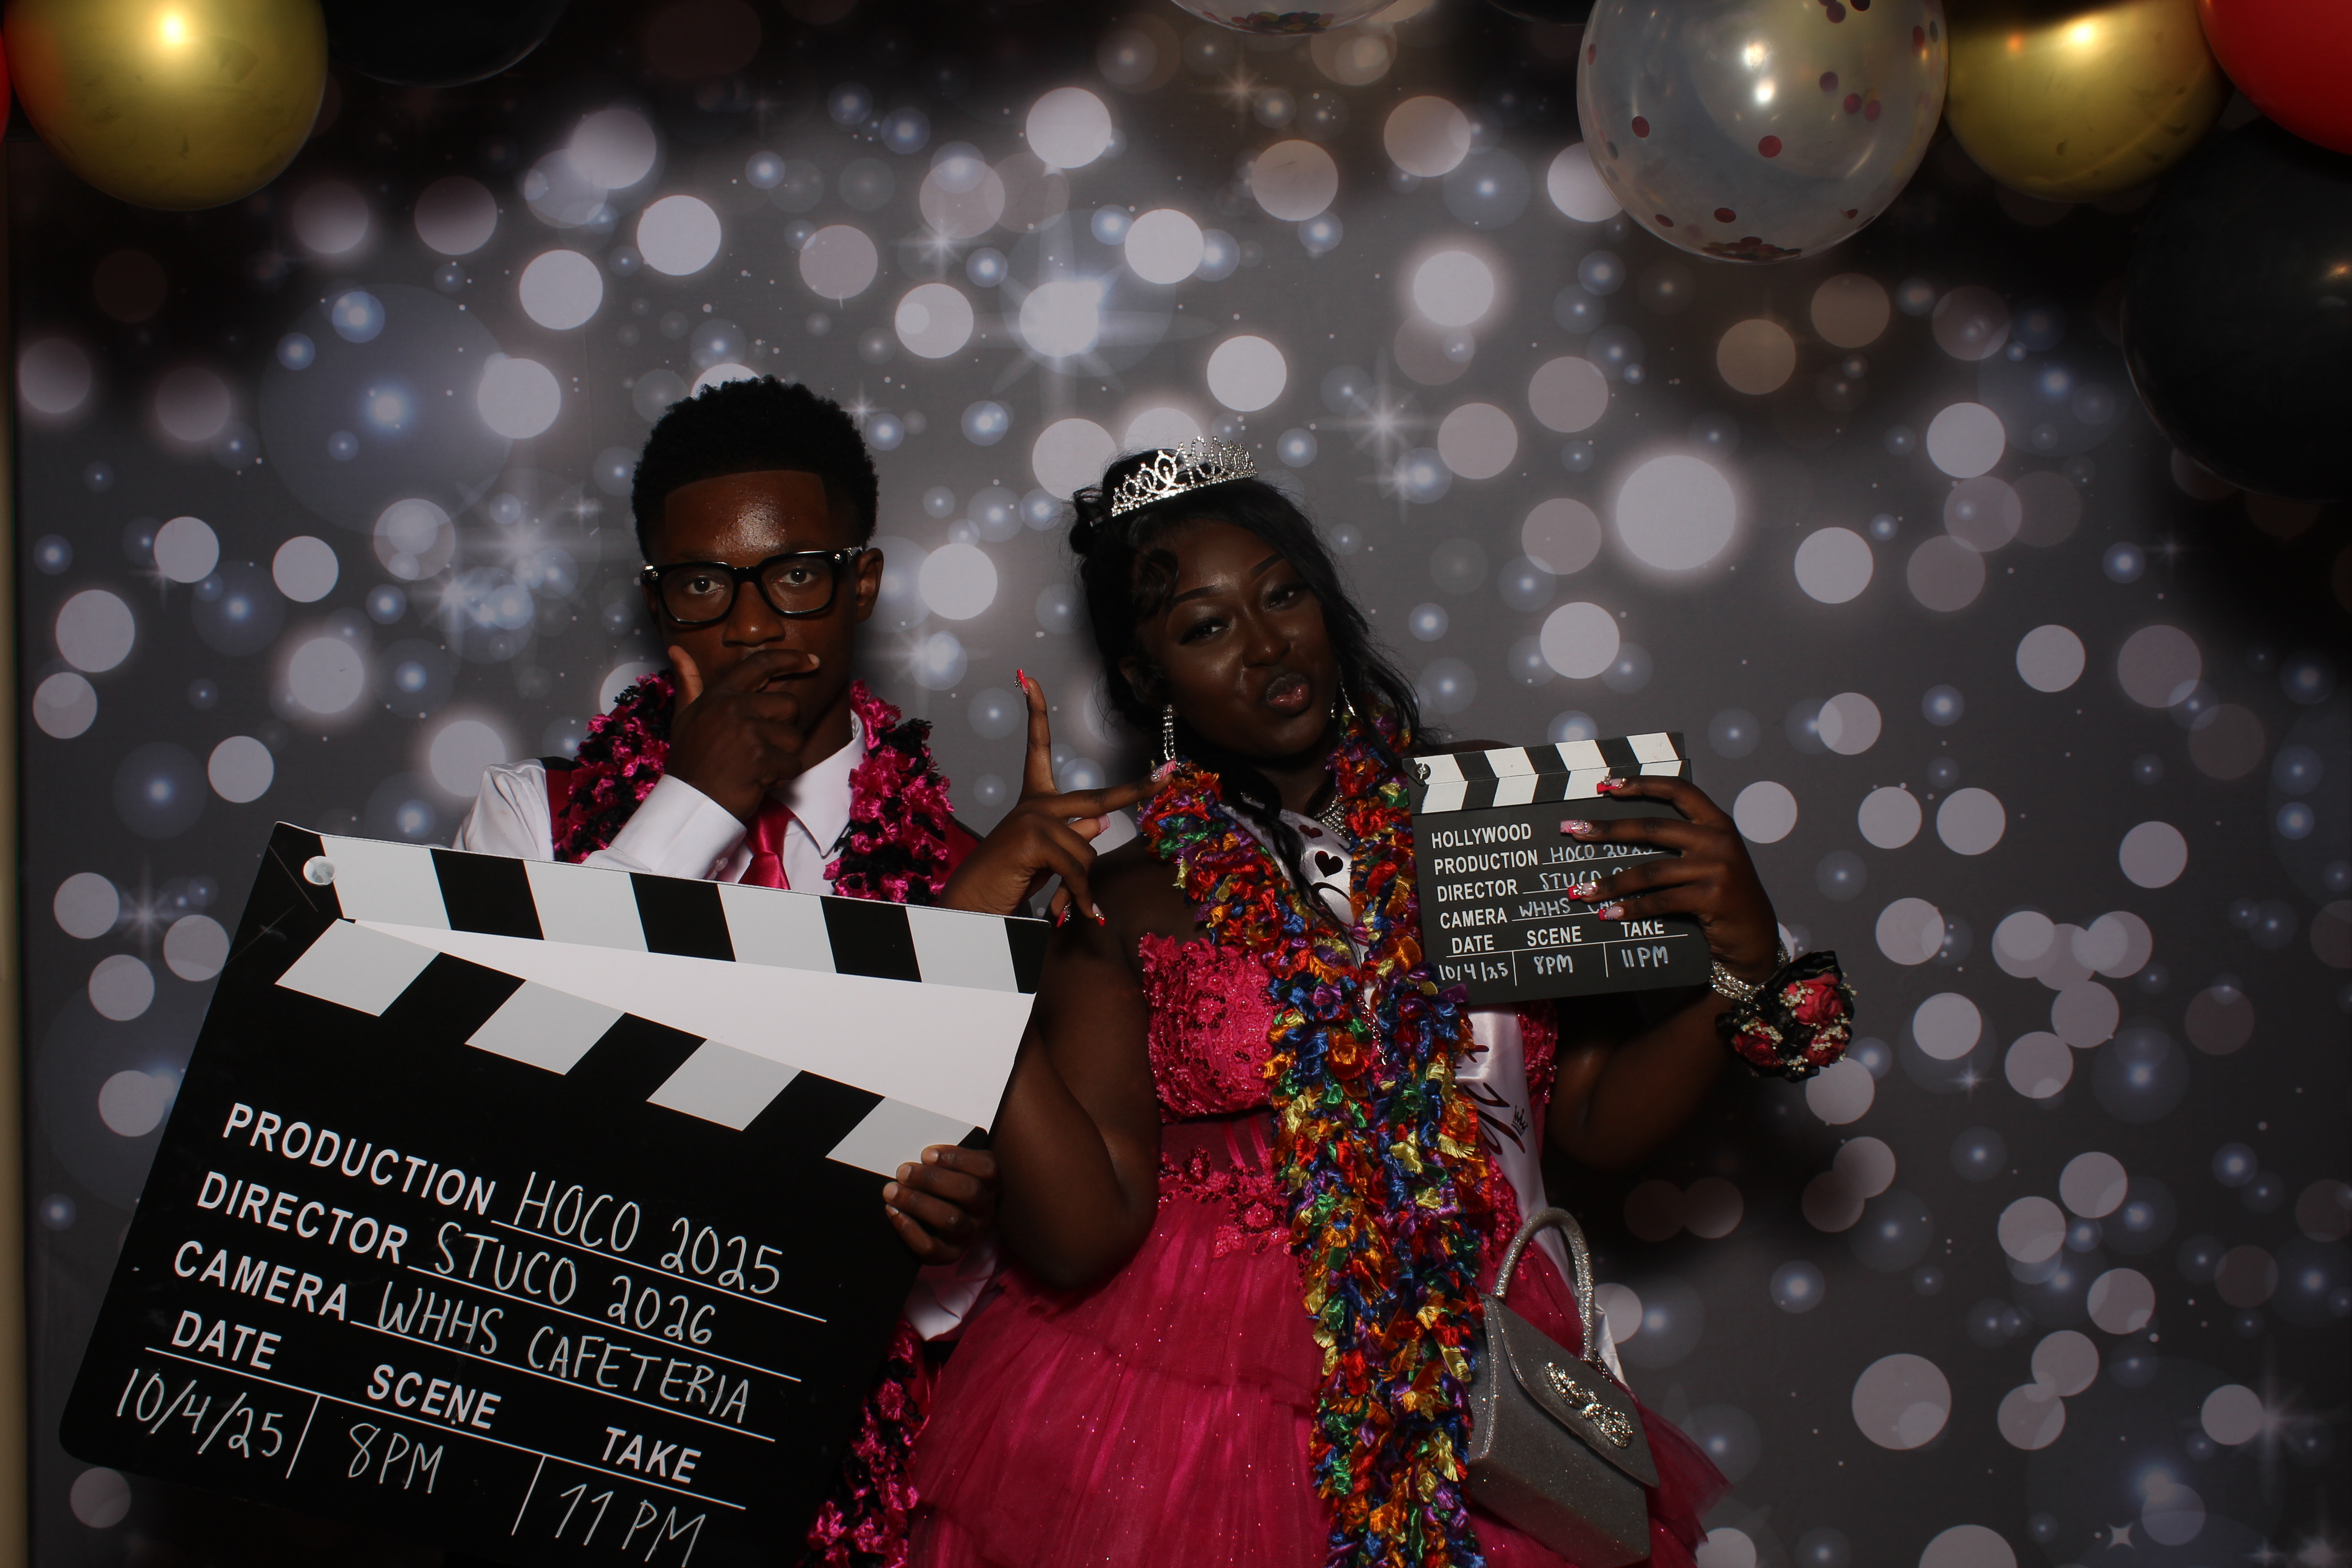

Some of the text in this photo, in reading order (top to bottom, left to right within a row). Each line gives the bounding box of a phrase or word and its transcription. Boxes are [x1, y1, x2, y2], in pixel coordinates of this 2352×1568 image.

[1431, 823, 1531, 849] HOLLYWOOD
[1434, 849, 1538, 875] PRODUCTION
[1550, 844, 1595, 862] HOCO
[1437, 879, 1518, 902] DIRECTOR
[1440, 907, 1508, 929] CAMERA
[1519, 897, 1571, 917] WHHS
[1620, 920, 1665, 937] TAKE
[1451, 934, 1494, 954] DATE
[1527, 926, 1582, 947] SCENE
[1439, 962, 1508, 982] 10/4/25
[1534, 954, 1573, 975] 8PM
[222, 1102, 783, 1294] PRODUCTION HOCO 2025
[197, 1171, 715, 1344] DIRECTOR STUCO 2026
[172, 1310, 282, 1370] DATE
[174, 1240, 749, 1423] CAMERA WHHS CAFETERIA
[367, 1364, 501, 1429] SCENE
[117, 1368, 283, 1458] 10/4/25
[348, 1423, 443, 1494] 8PM
[602, 1426, 701, 1484] TAKE
